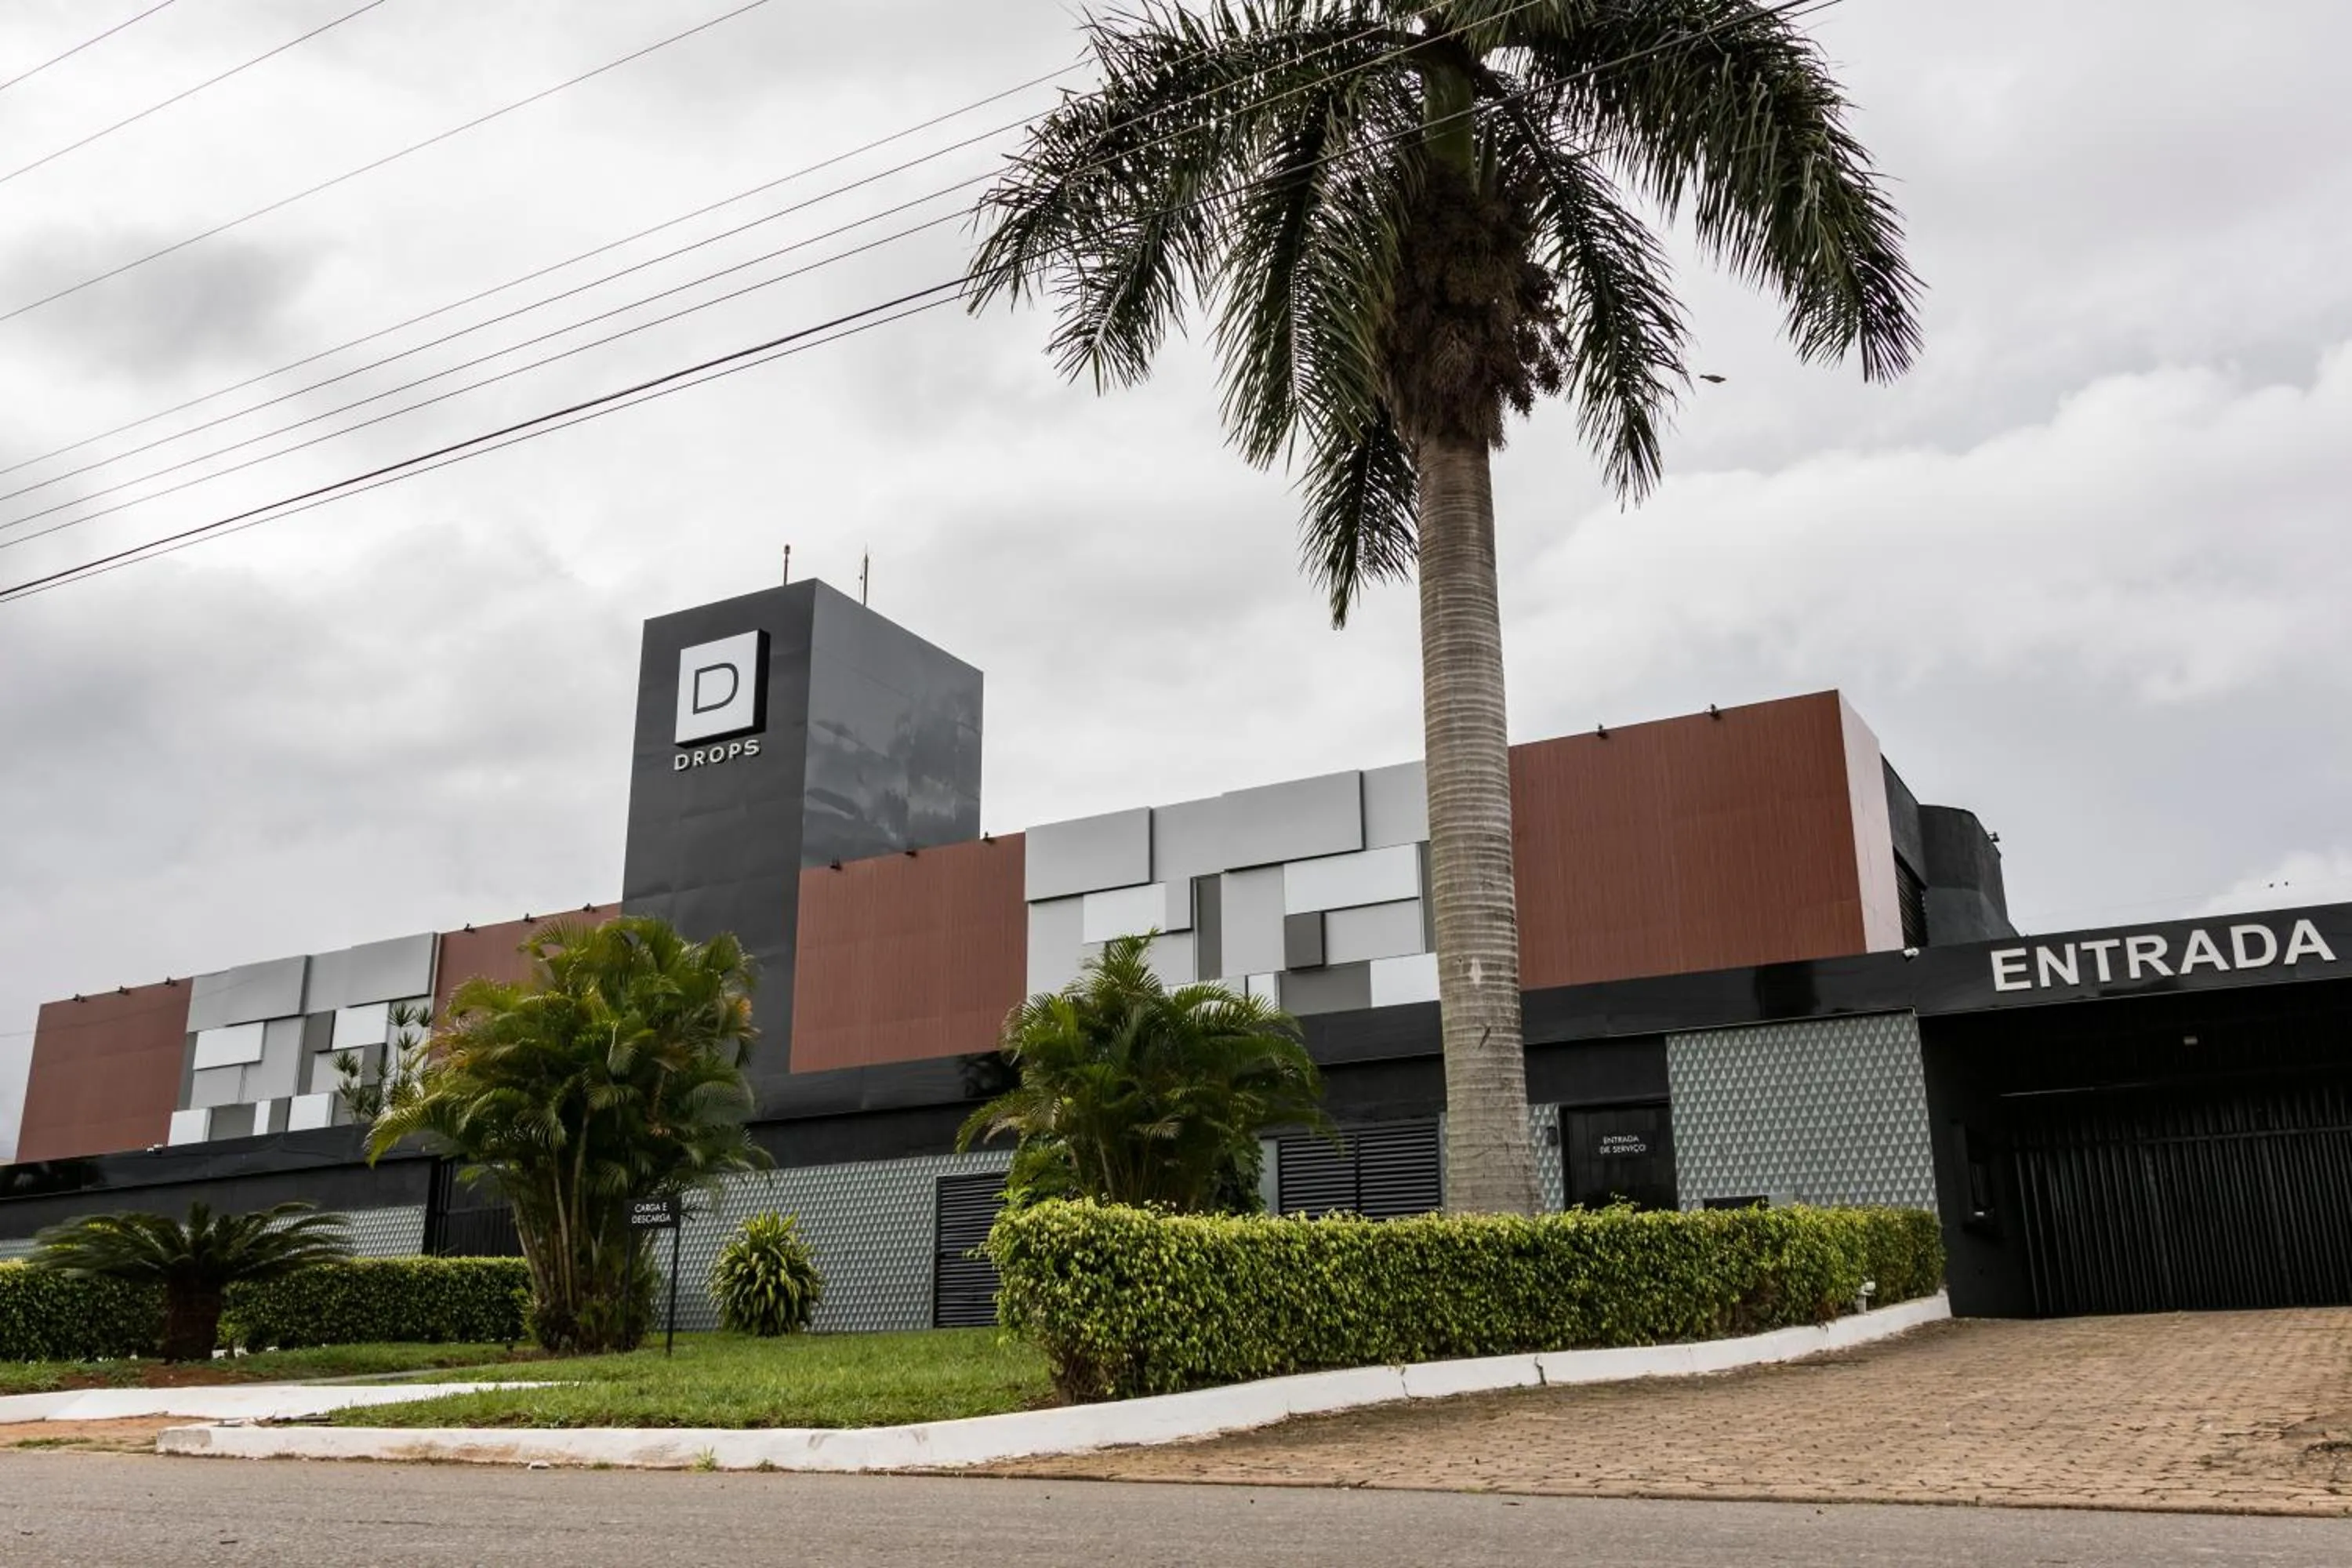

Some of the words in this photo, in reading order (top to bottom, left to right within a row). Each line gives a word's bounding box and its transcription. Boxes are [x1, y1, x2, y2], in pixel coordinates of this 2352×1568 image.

[692, 662, 739, 715] D
[673, 739, 761, 771] DROPS
[1990, 918, 2337, 992] ENTRADA
[1603, 1135, 1639, 1145] ENTRADA
[1599, 1145, 1611, 1155] DE
[1613, 1144, 1646, 1154] SERVIÇO
[634, 1203, 661, 1213] CARGA
[662, 1202, 668, 1212] E
[631, 1214, 672, 1224] DESCARGA
